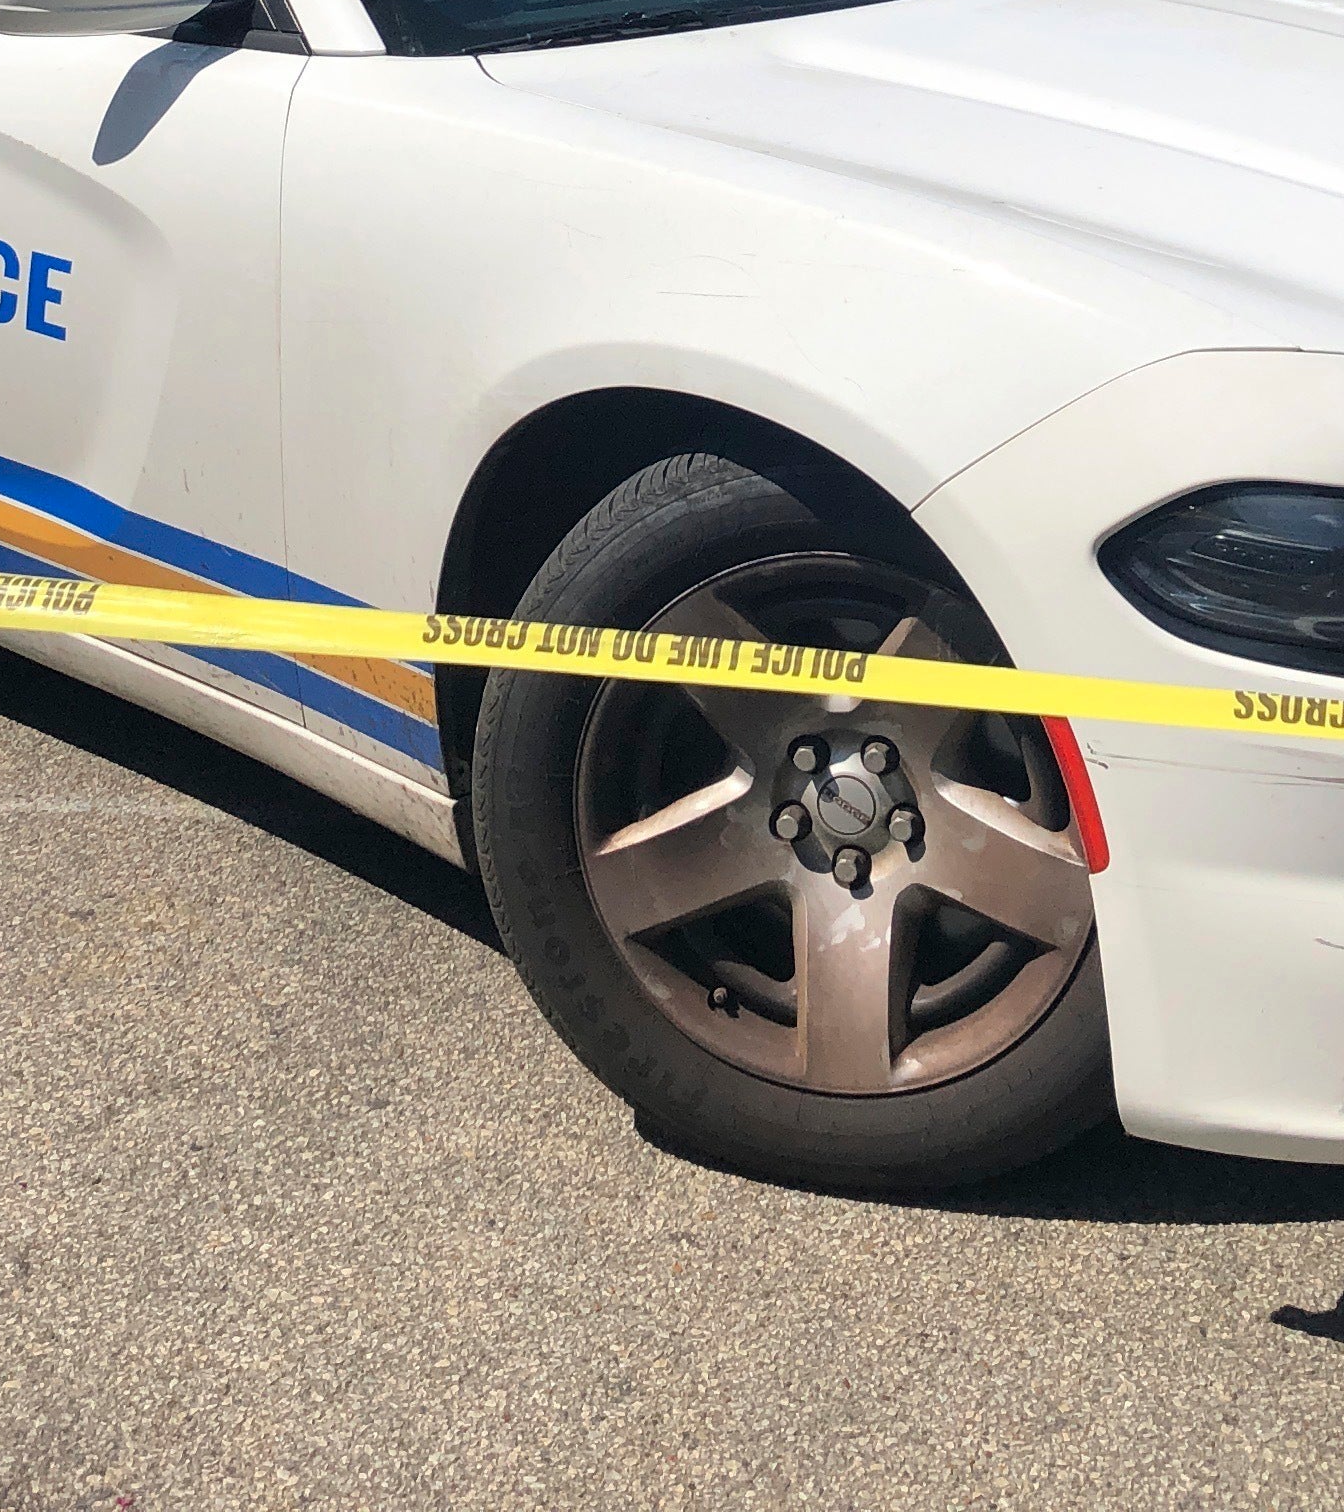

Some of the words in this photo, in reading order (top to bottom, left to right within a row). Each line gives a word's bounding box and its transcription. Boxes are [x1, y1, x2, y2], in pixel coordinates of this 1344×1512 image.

[422, 614, 529, 650] CROSS
[535, 624, 602, 657] NOT
[611, 630, 657, 663] DO
[667, 634, 741, 671] LINE
[752, 640, 867, 683] POLICE
